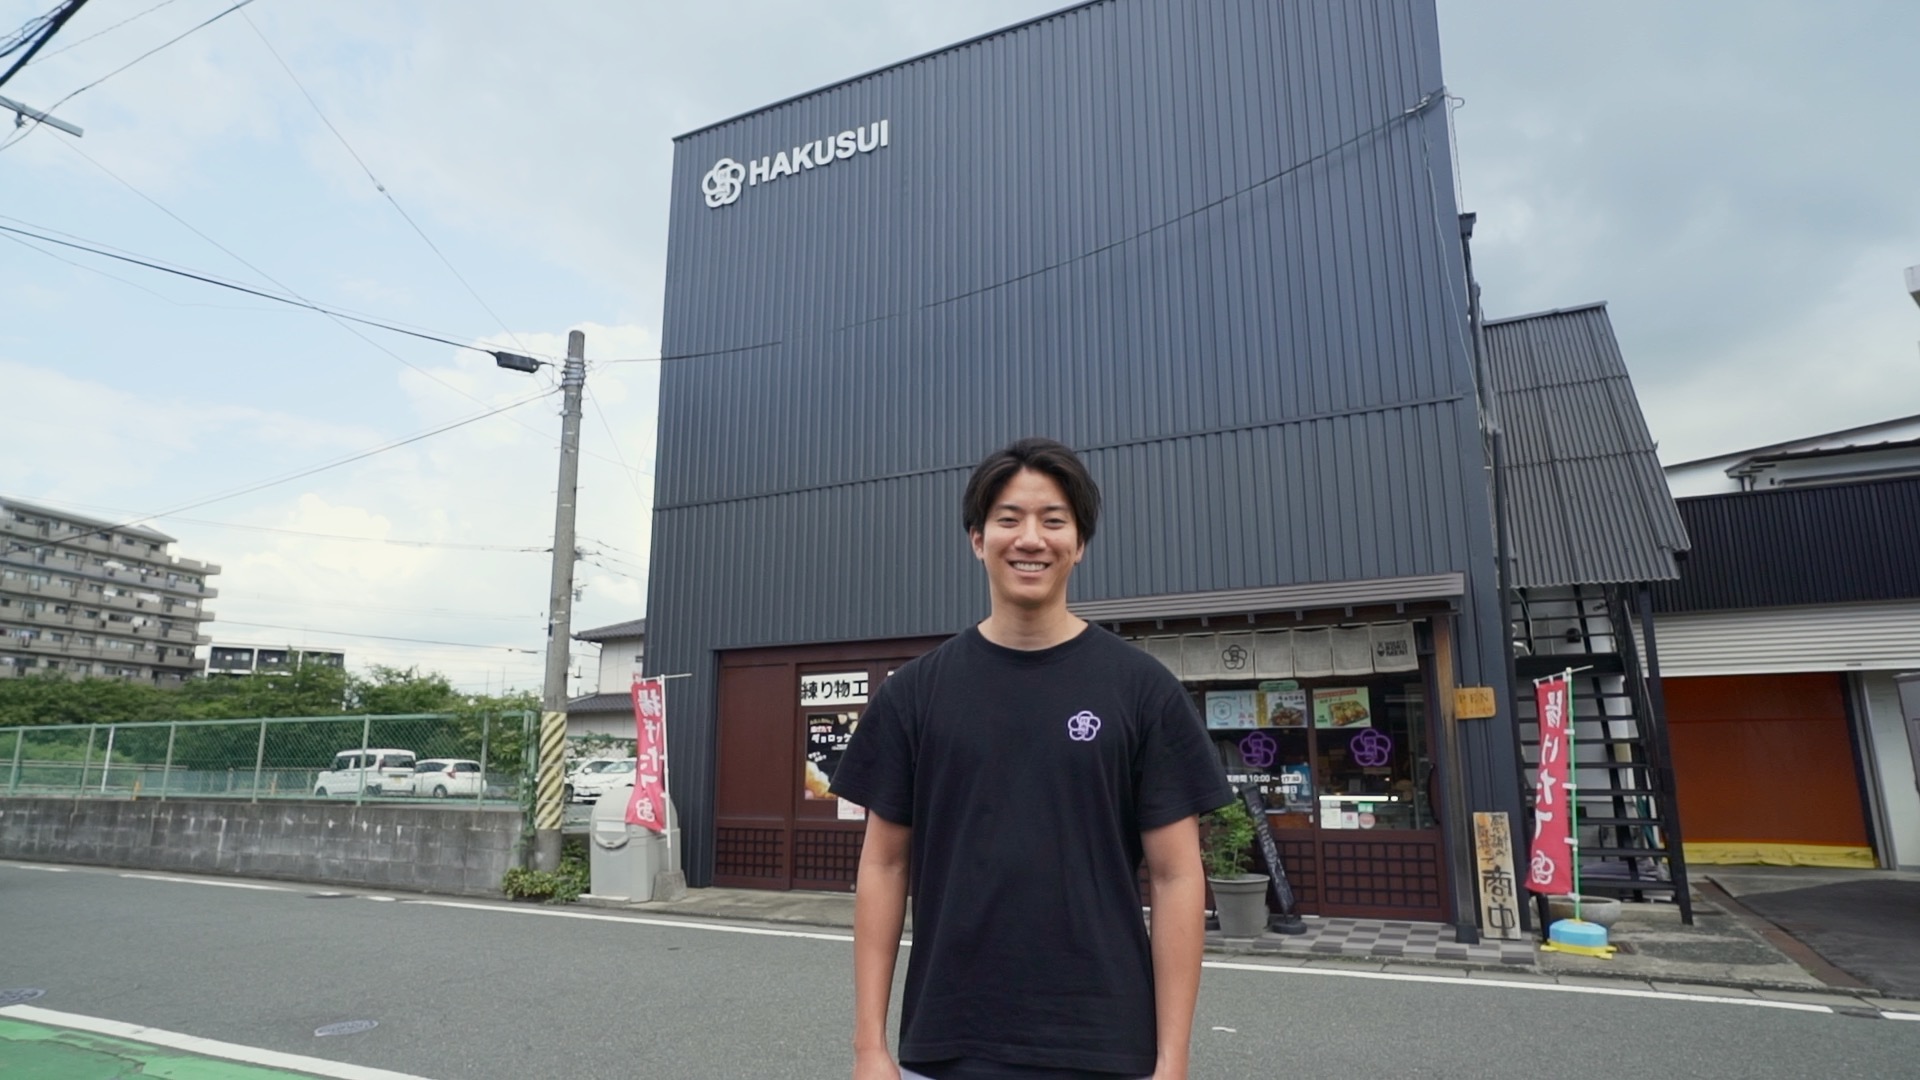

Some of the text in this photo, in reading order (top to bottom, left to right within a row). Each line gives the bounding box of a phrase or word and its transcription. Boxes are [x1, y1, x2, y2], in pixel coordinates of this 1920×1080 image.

[749, 119, 889, 186] HAKUSUI
[801, 679, 868, 700] 練り物工
[1459, 693, 1489, 704] PEN
[1249, 774, 1271, 783] 10:00
